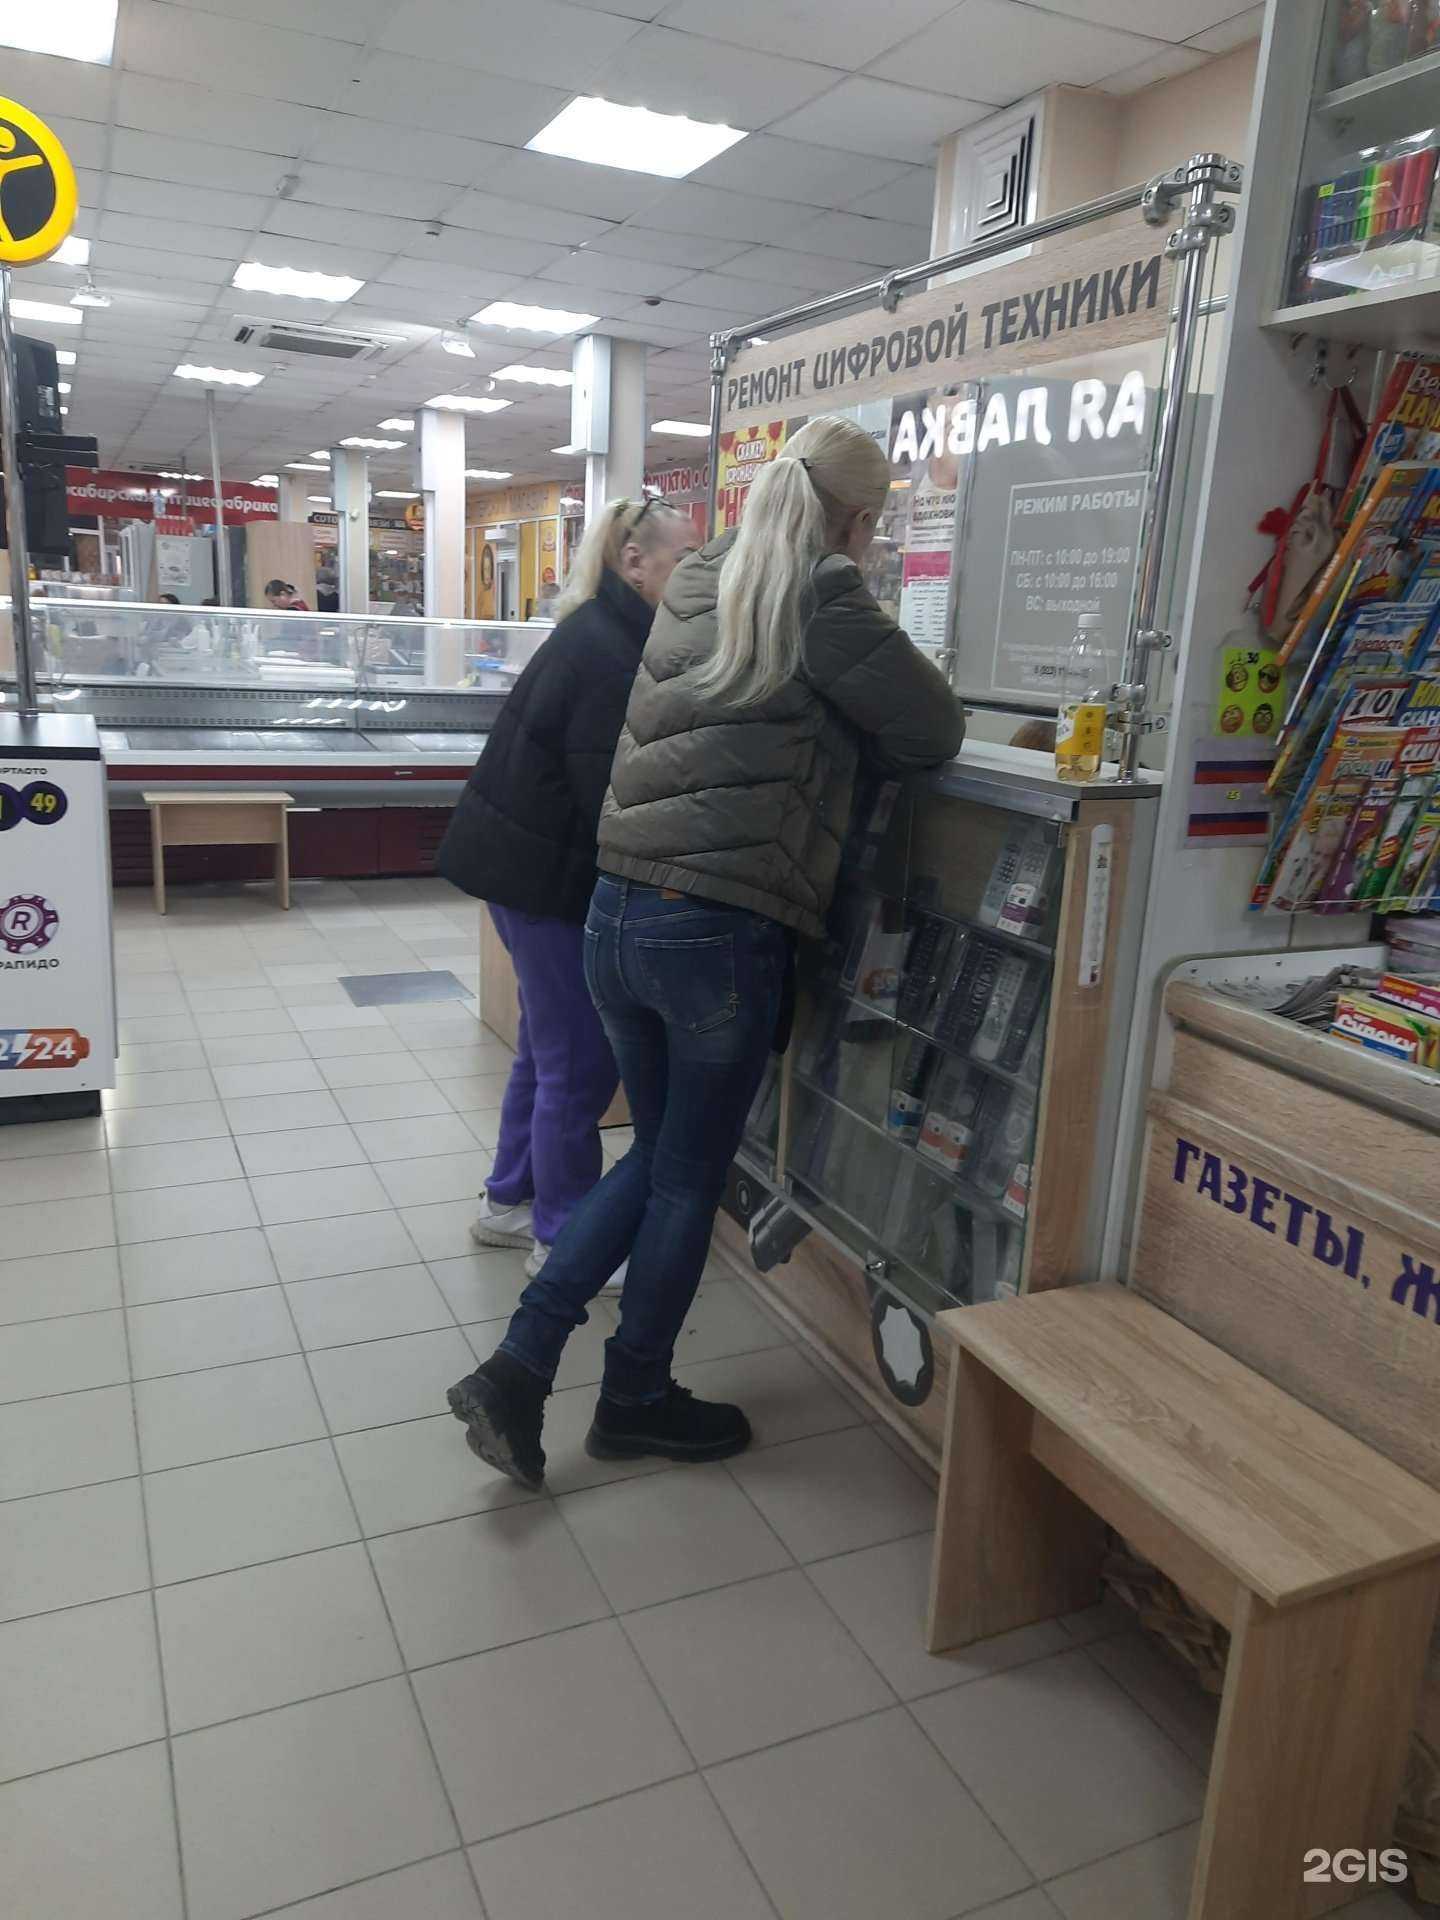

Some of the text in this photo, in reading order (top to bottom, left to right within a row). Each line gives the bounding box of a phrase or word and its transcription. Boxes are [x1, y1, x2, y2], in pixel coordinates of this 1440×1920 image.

[727, 254, 1162, 412] РЕМОНТ ЦИФРОВОЙ ТЕХНИКИ
[1014, 489, 1140, 516] РЕЖИМ РАБОТЫ
[1010, 550, 1044, 567] ПН-ПТ:
[1083, 552, 1098, 566] до
[1071, 575, 1086, 590] до
[31, 792, 57, 813] 49
[11, 911, 31, 931] R
[1173, 1138, 1371, 1290] ГАЗЕТЫ,
